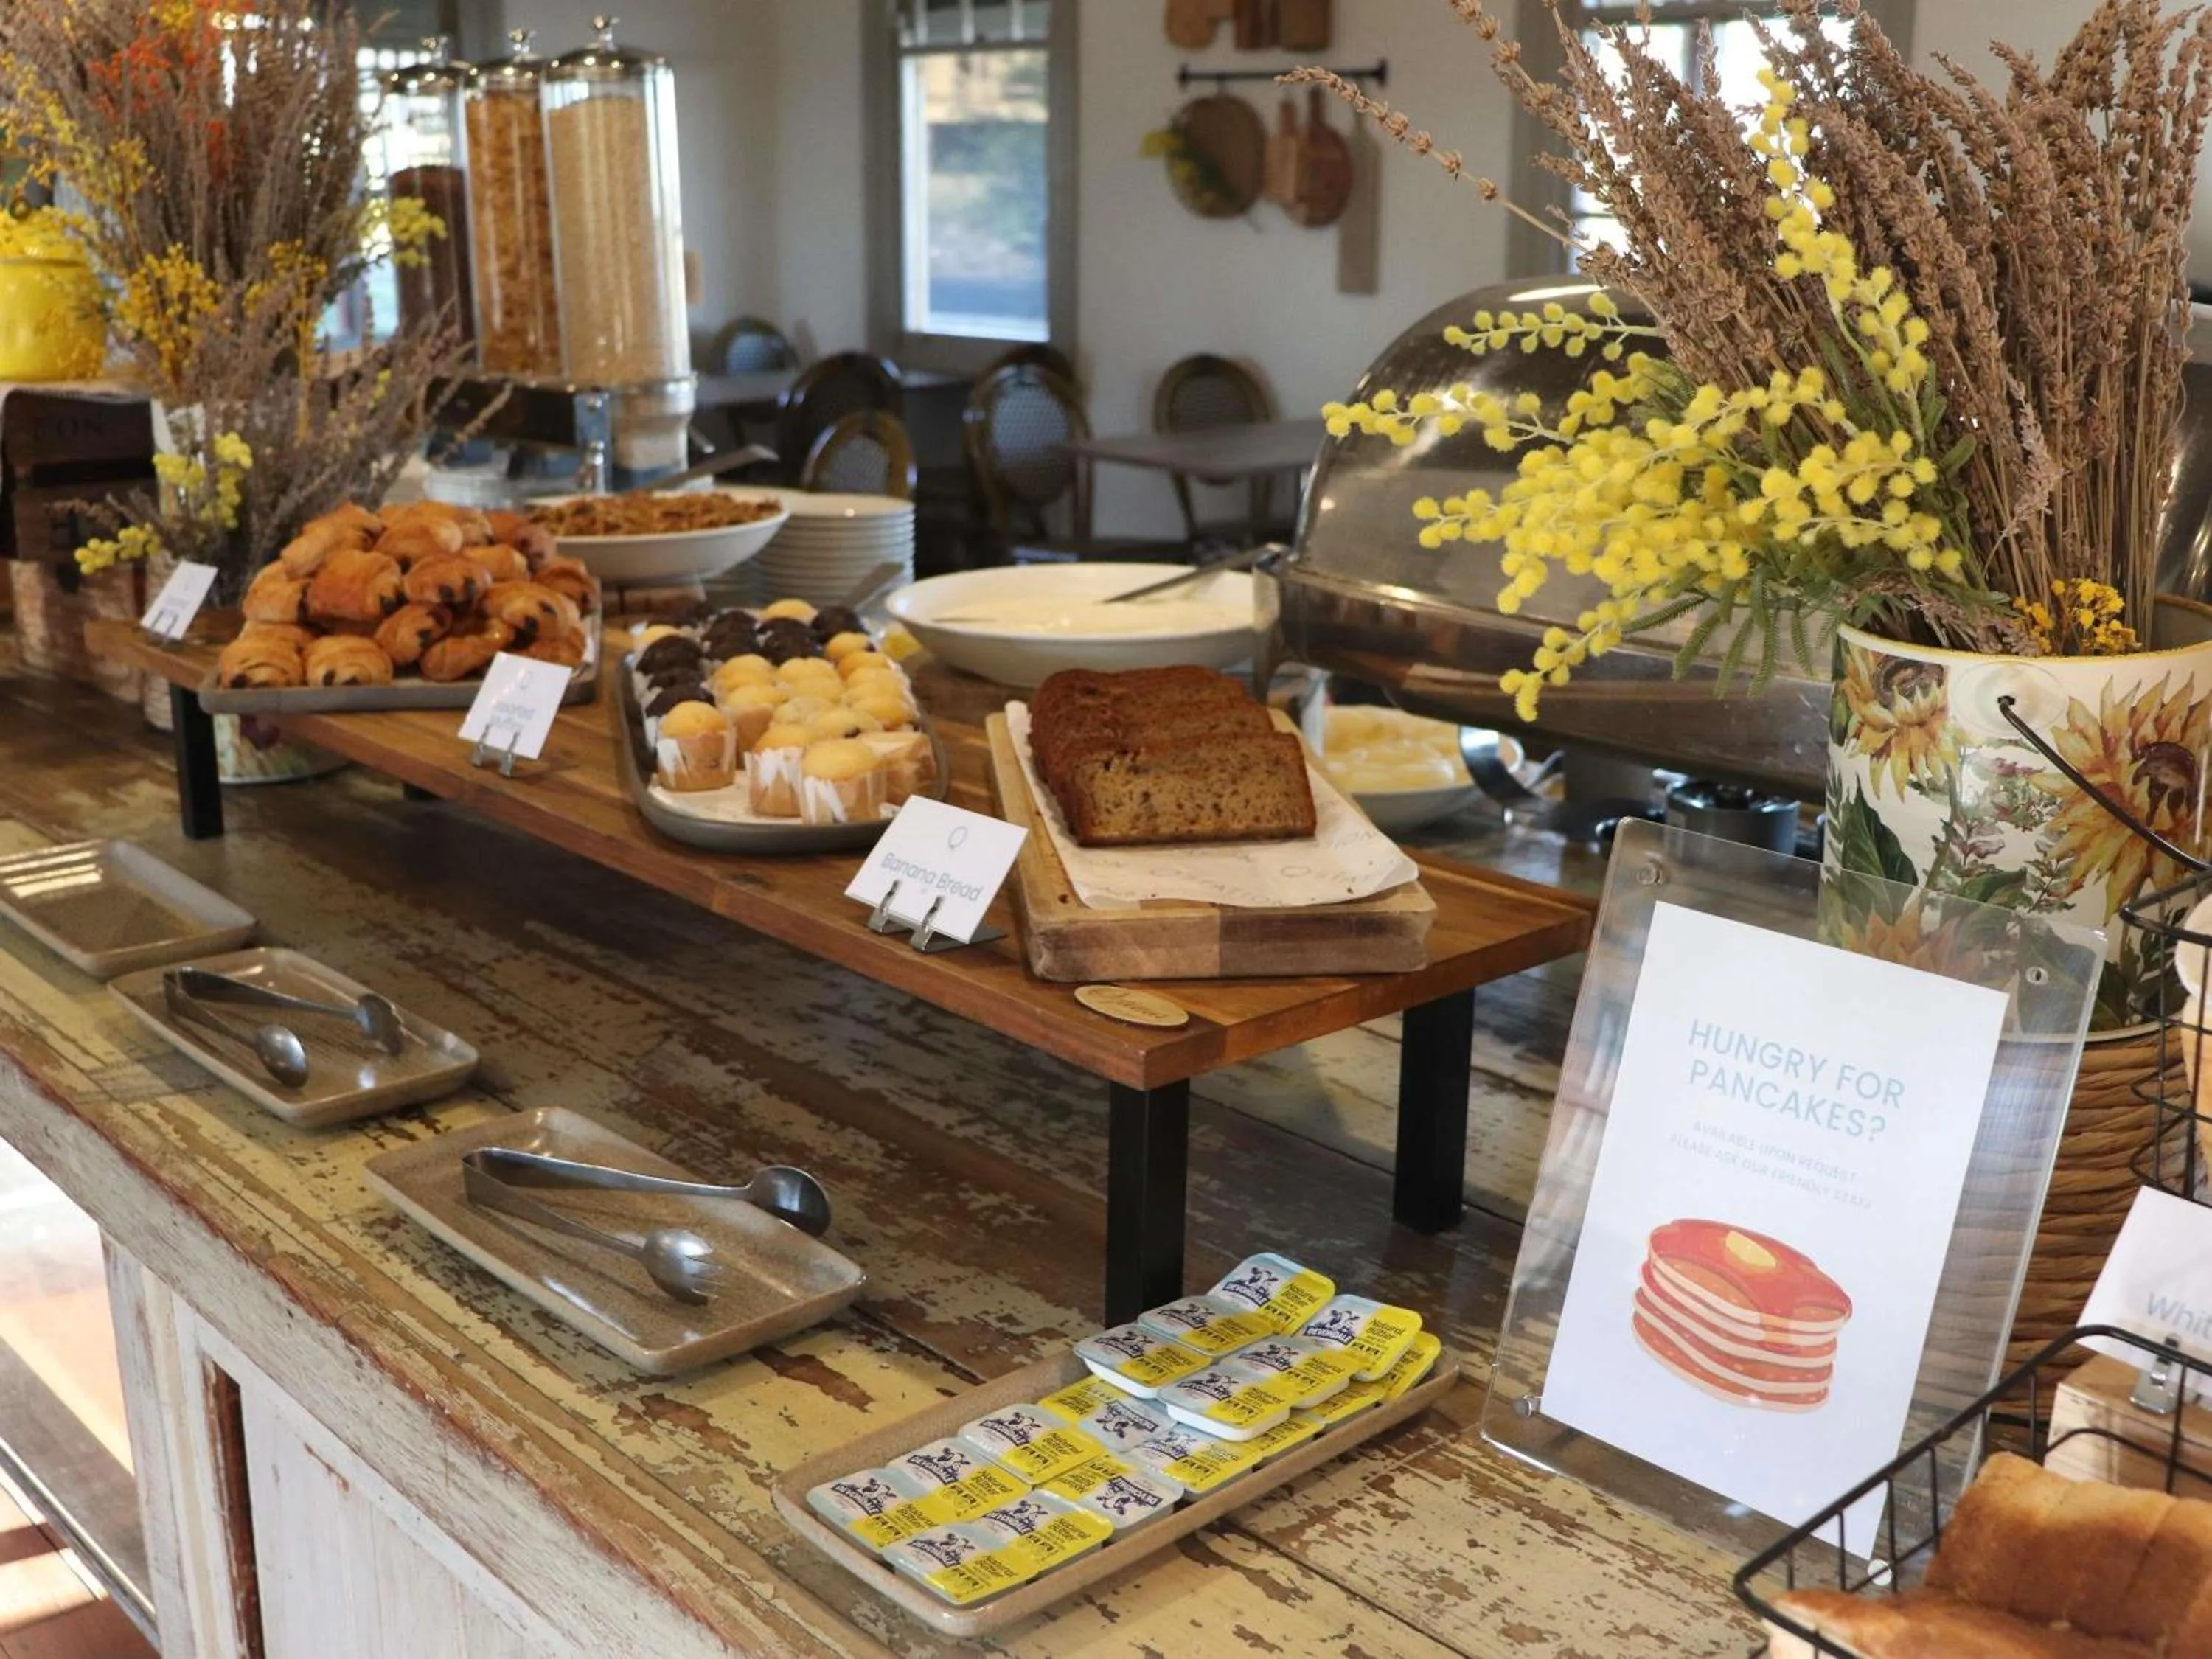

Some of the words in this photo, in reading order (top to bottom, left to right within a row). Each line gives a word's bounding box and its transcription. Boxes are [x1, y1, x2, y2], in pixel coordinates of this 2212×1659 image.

[881, 852, 936, 884] Banana
[935, 872, 984, 901] Bread
[1688, 1019, 1828, 1083] HUNGRY
[1836, 1063, 1905, 1108] FOR
[1690, 1059, 1885, 1141] PANCAKES?
[1692, 1121, 1756, 1151] AVAILABLE
[1759, 1142, 1796, 1165] UPON
[1798, 1155, 1857, 1182] REQUEST
[2147, 1292, 2211, 1339] Whit
